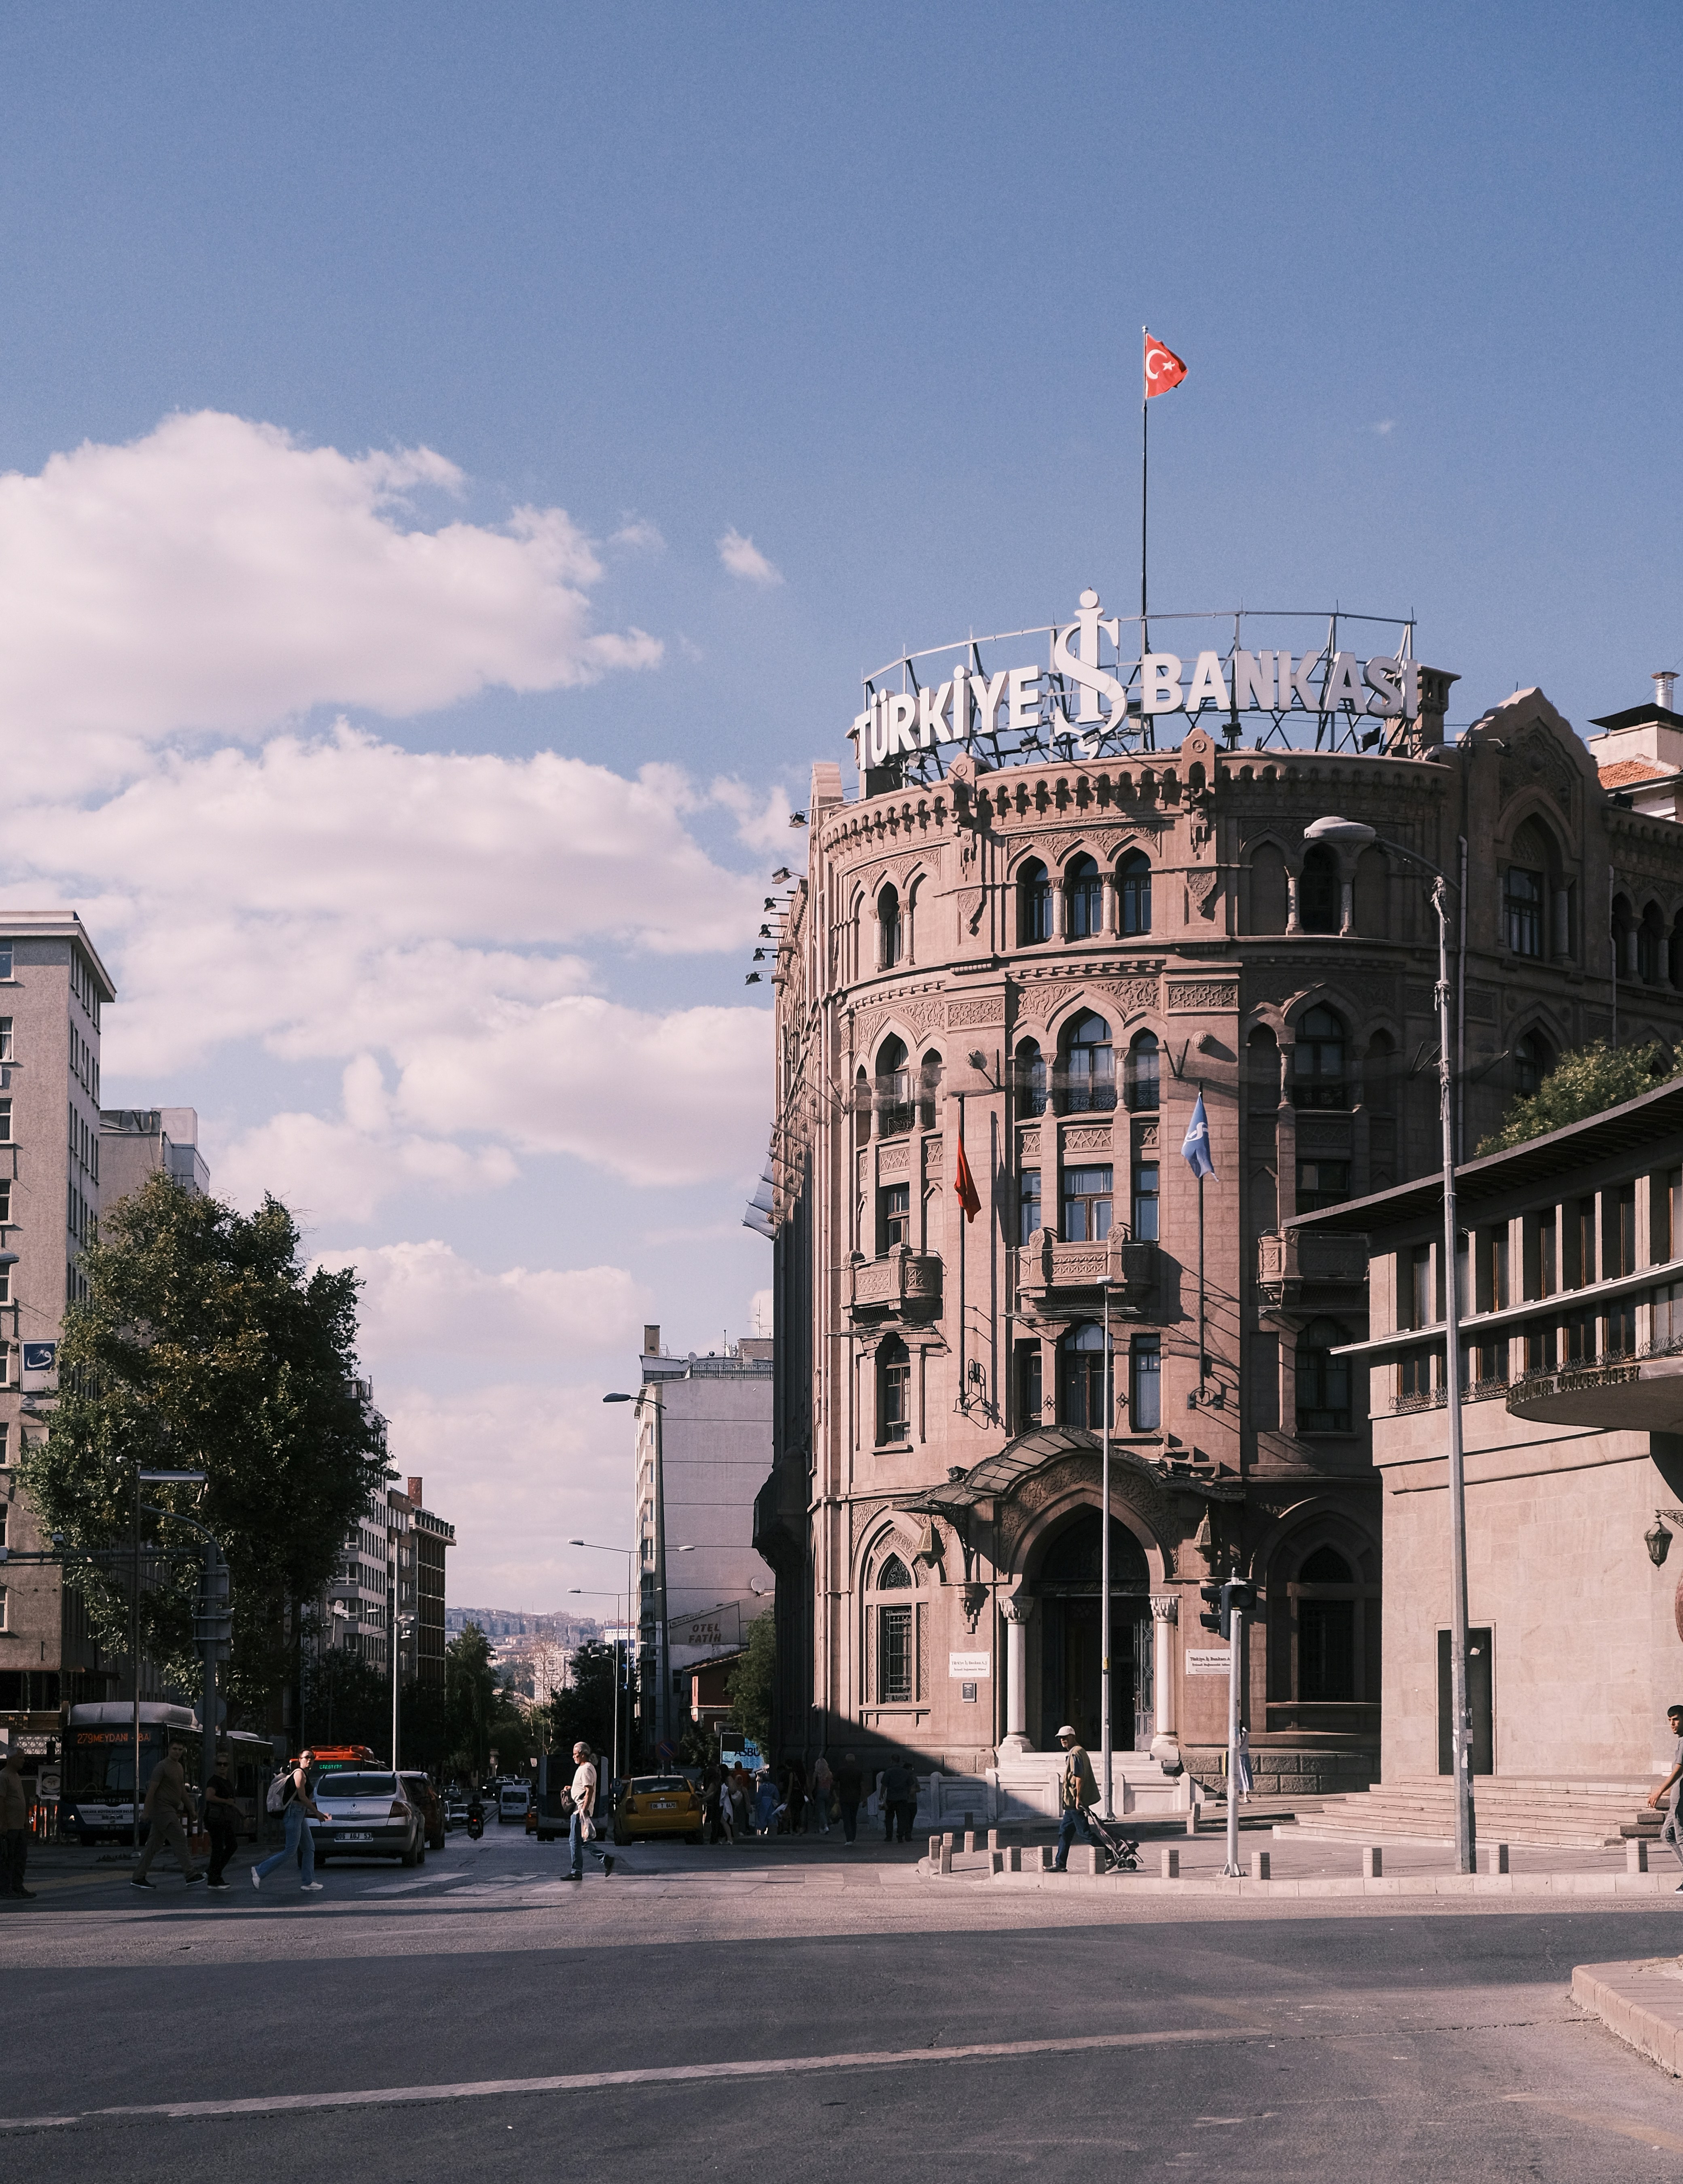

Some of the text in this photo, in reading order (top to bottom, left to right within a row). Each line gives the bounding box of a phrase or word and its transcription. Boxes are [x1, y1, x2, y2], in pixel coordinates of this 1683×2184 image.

[854, 665, 1043, 771] TÜRKİYE
[1143, 649, 1418, 719] BANKASI
[692, 1623, 720, 1632] OTEL
[688, 1631, 721, 1643] FATİH
[77, 1733, 93, 1744] 279
[93, 1733, 128, 1743] MEYDANI
